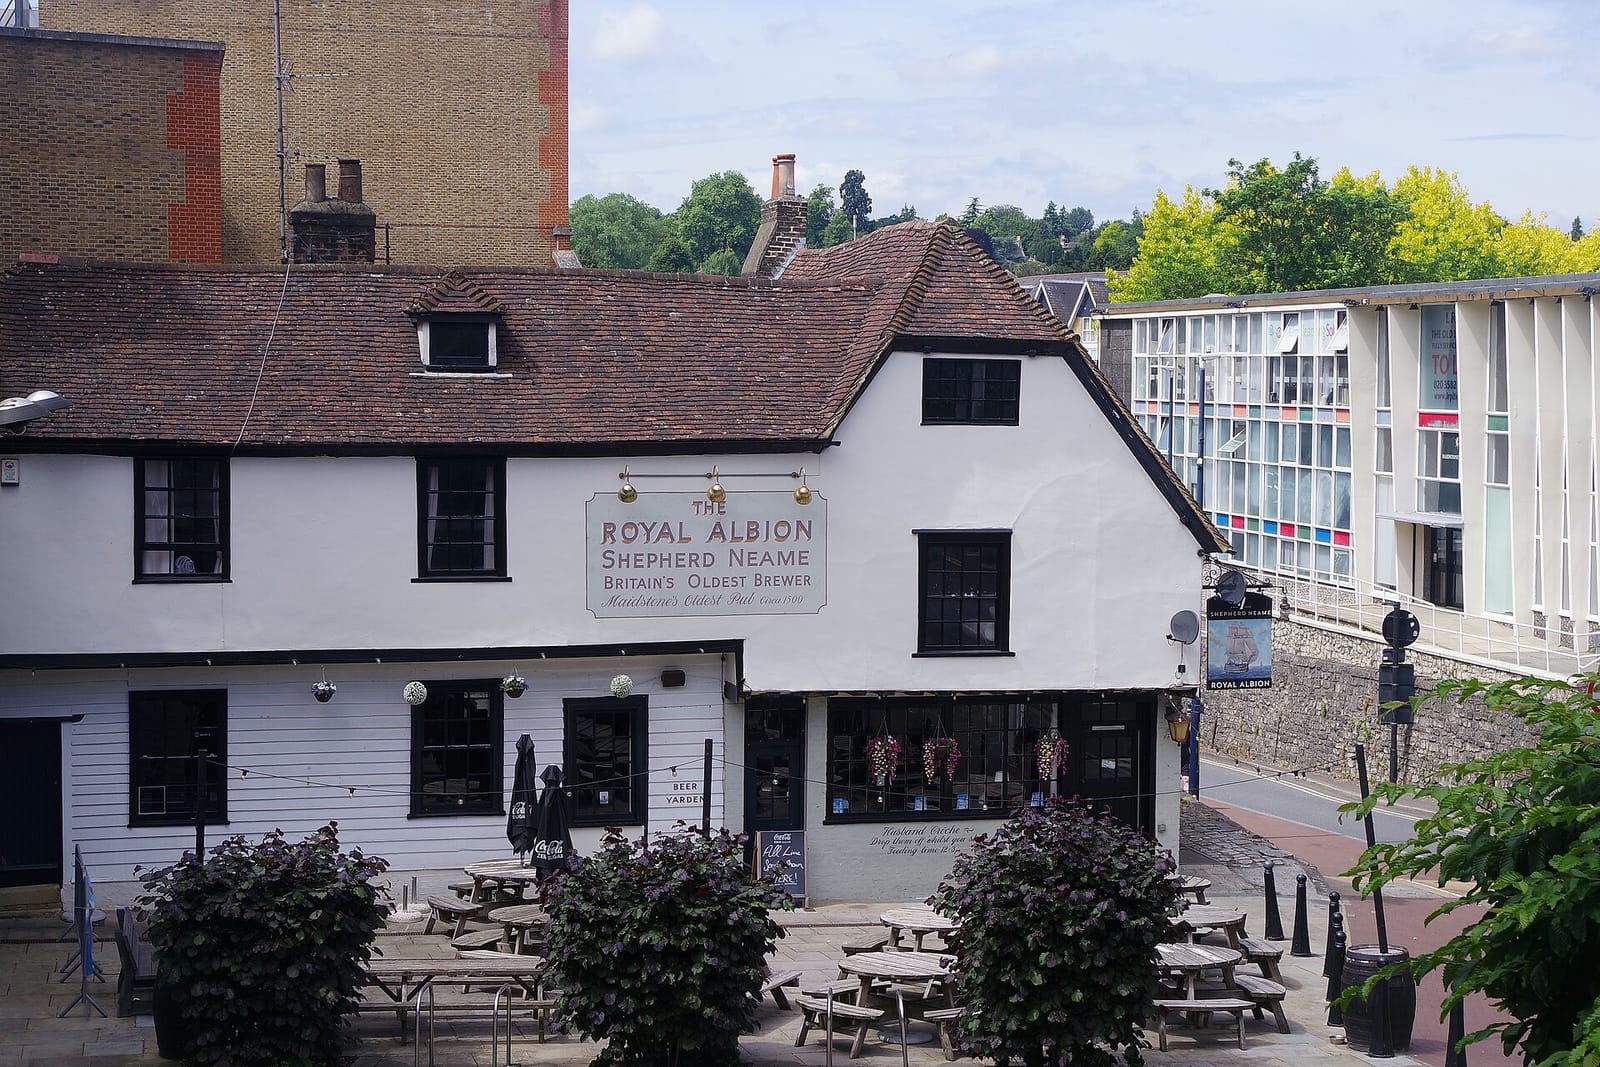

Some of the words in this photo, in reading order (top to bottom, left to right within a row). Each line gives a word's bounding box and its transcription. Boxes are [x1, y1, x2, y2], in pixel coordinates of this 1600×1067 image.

[1432, 354, 1450, 375] TO
[691, 500, 726, 515] THE
[600, 521, 692, 545] ROYAL
[705, 519, 813, 544] ALBION
[602, 549, 716, 569] SHEPHERD
[729, 548, 809, 567] NEAME
[604, 575, 675, 590] BRITAIN'S
[688, 573, 747, 589] OLDEST
[754, 573, 811, 587] BREWER
[600, 593, 678, 608] Maidstone's
[684, 593, 722, 607] Oldest
[726, 592, 756, 606] Pub
[1211, 681, 1237, 689] ROYAL
[1239, 680, 1271, 688] ALBION
[673, 783, 698, 791] BEER
[666, 796, 705, 804] YARDEN
[881, 825, 927, 837] Husband
[869, 838, 890, 849] Drop
[892, 837, 912, 846] them
[914, 837, 923, 847] off
[926, 835, 950, 844] whilst
[951, 837, 966, 846] you
[762, 844, 782, 858] All
[887, 846, 918, 856] Feeding
[921, 846, 938, 854] time
